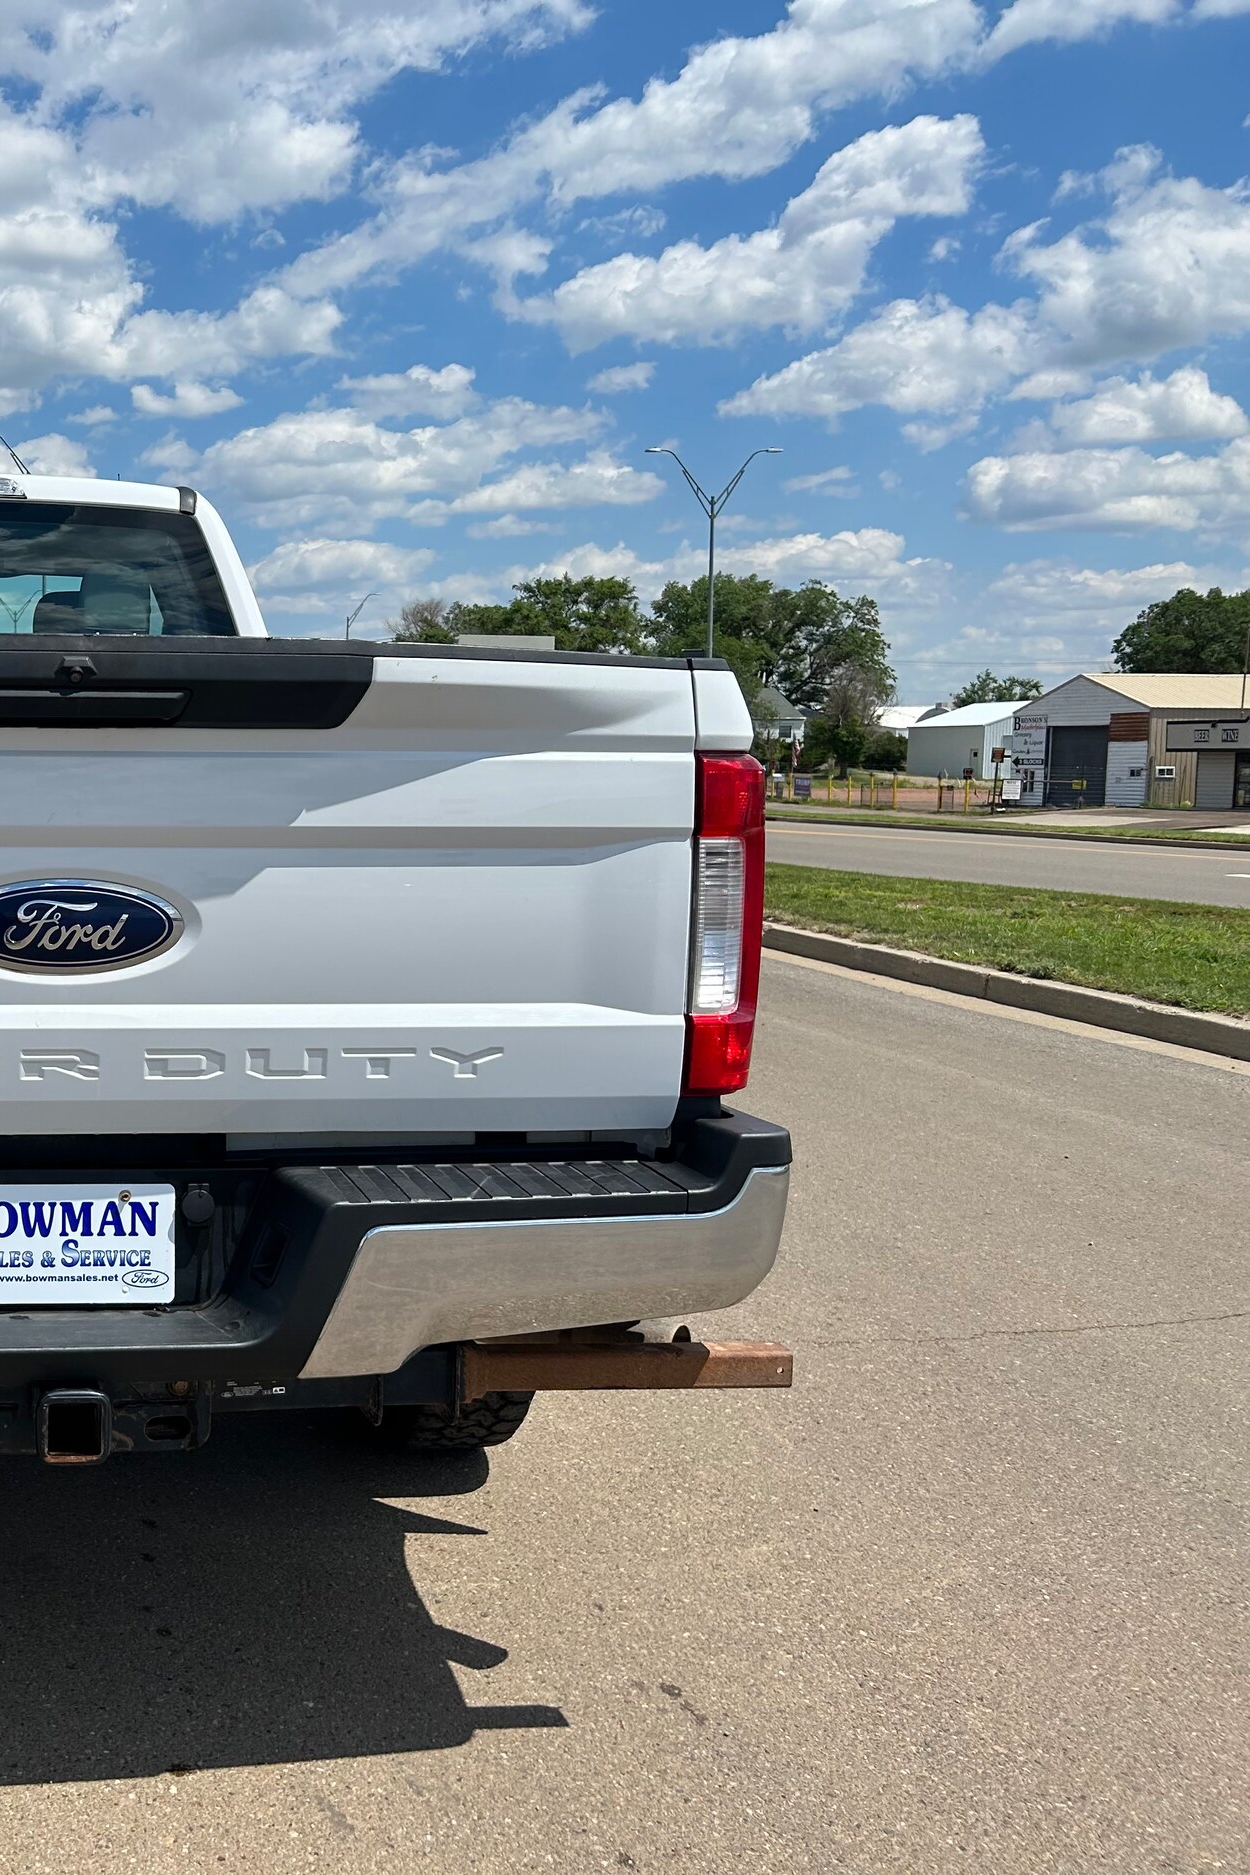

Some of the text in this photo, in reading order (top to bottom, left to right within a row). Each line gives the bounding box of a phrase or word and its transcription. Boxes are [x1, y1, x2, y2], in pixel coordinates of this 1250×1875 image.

[3, 899, 129, 951] Ford
[143, 1045, 505, 1081] DUTY
[40, 1251, 56, 1268] &
[131, 1271, 160, 1285] Ford
